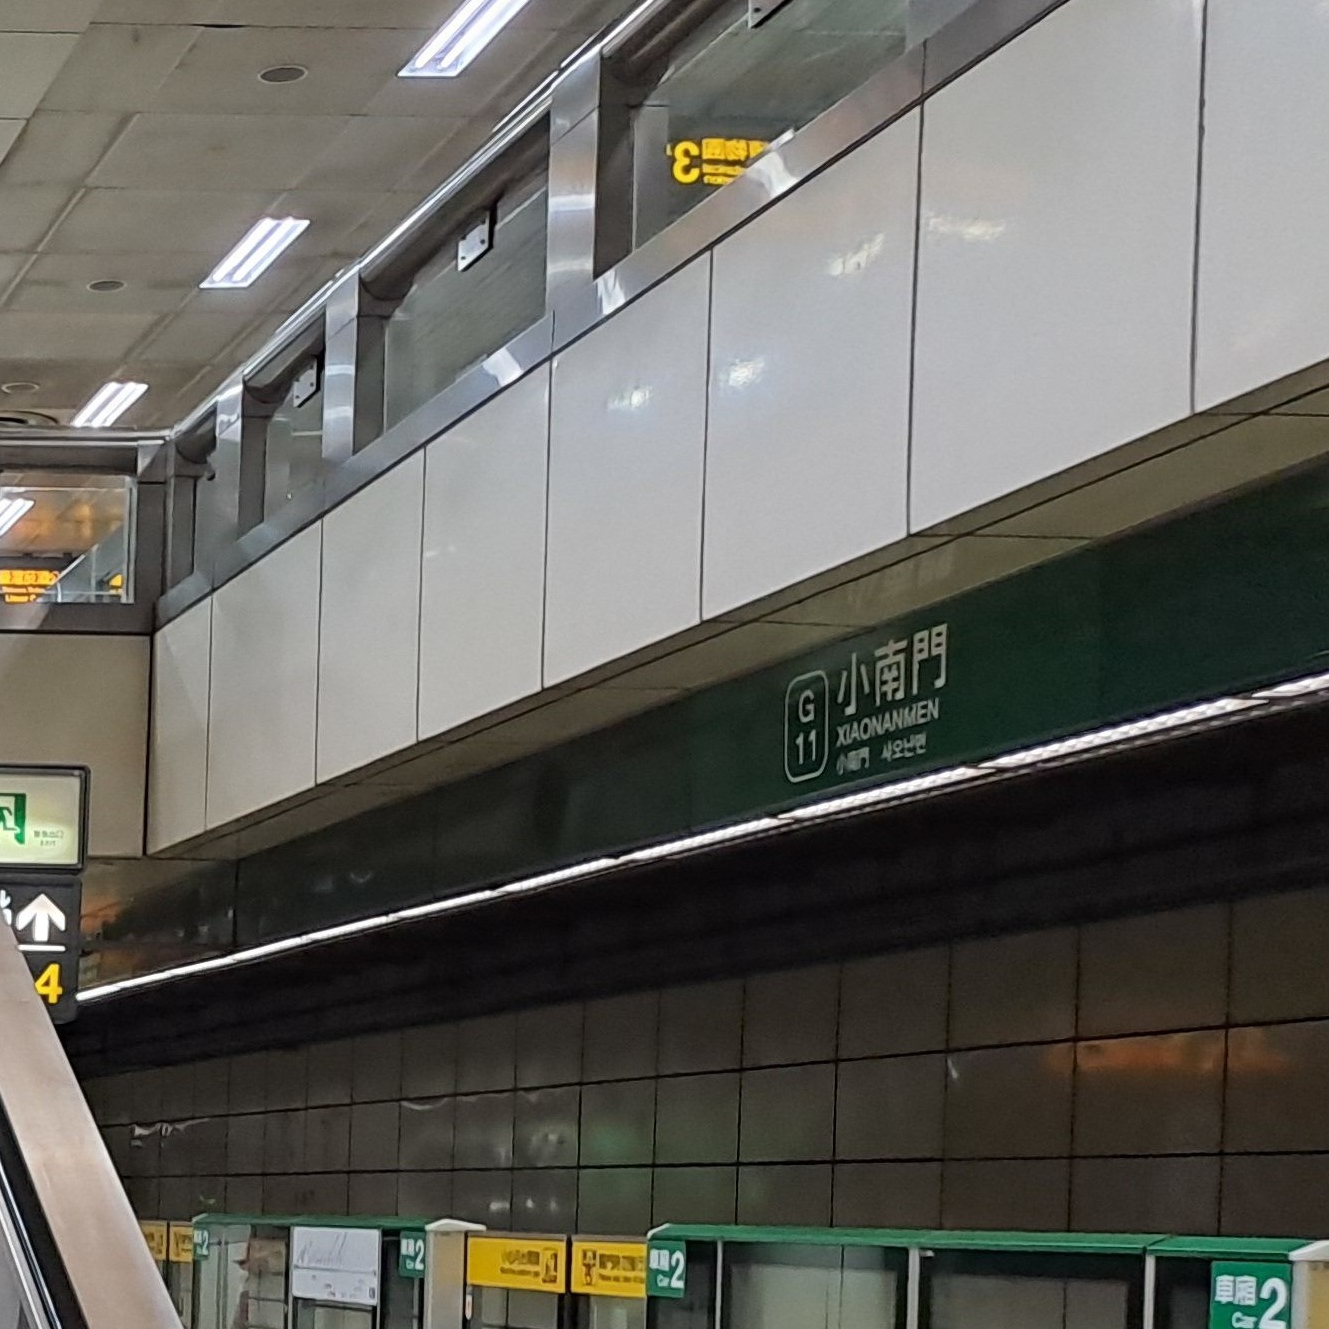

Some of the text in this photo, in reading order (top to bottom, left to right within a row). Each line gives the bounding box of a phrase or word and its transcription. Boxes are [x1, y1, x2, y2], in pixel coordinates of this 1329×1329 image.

[837, 623, 948, 716] 小南門
[799, 690, 815, 723] G
[836, 697, 939, 747] XIAONANMEN
[795, 729, 817, 765] 11
[35, 963, 63, 1004] 4
[415, 1239, 425, 1270] 2
[671, 1250, 685, 1289] 2
[1215, 1275, 1257, 1306] 車廂
[1232, 1311, 1258, 1329] Car
